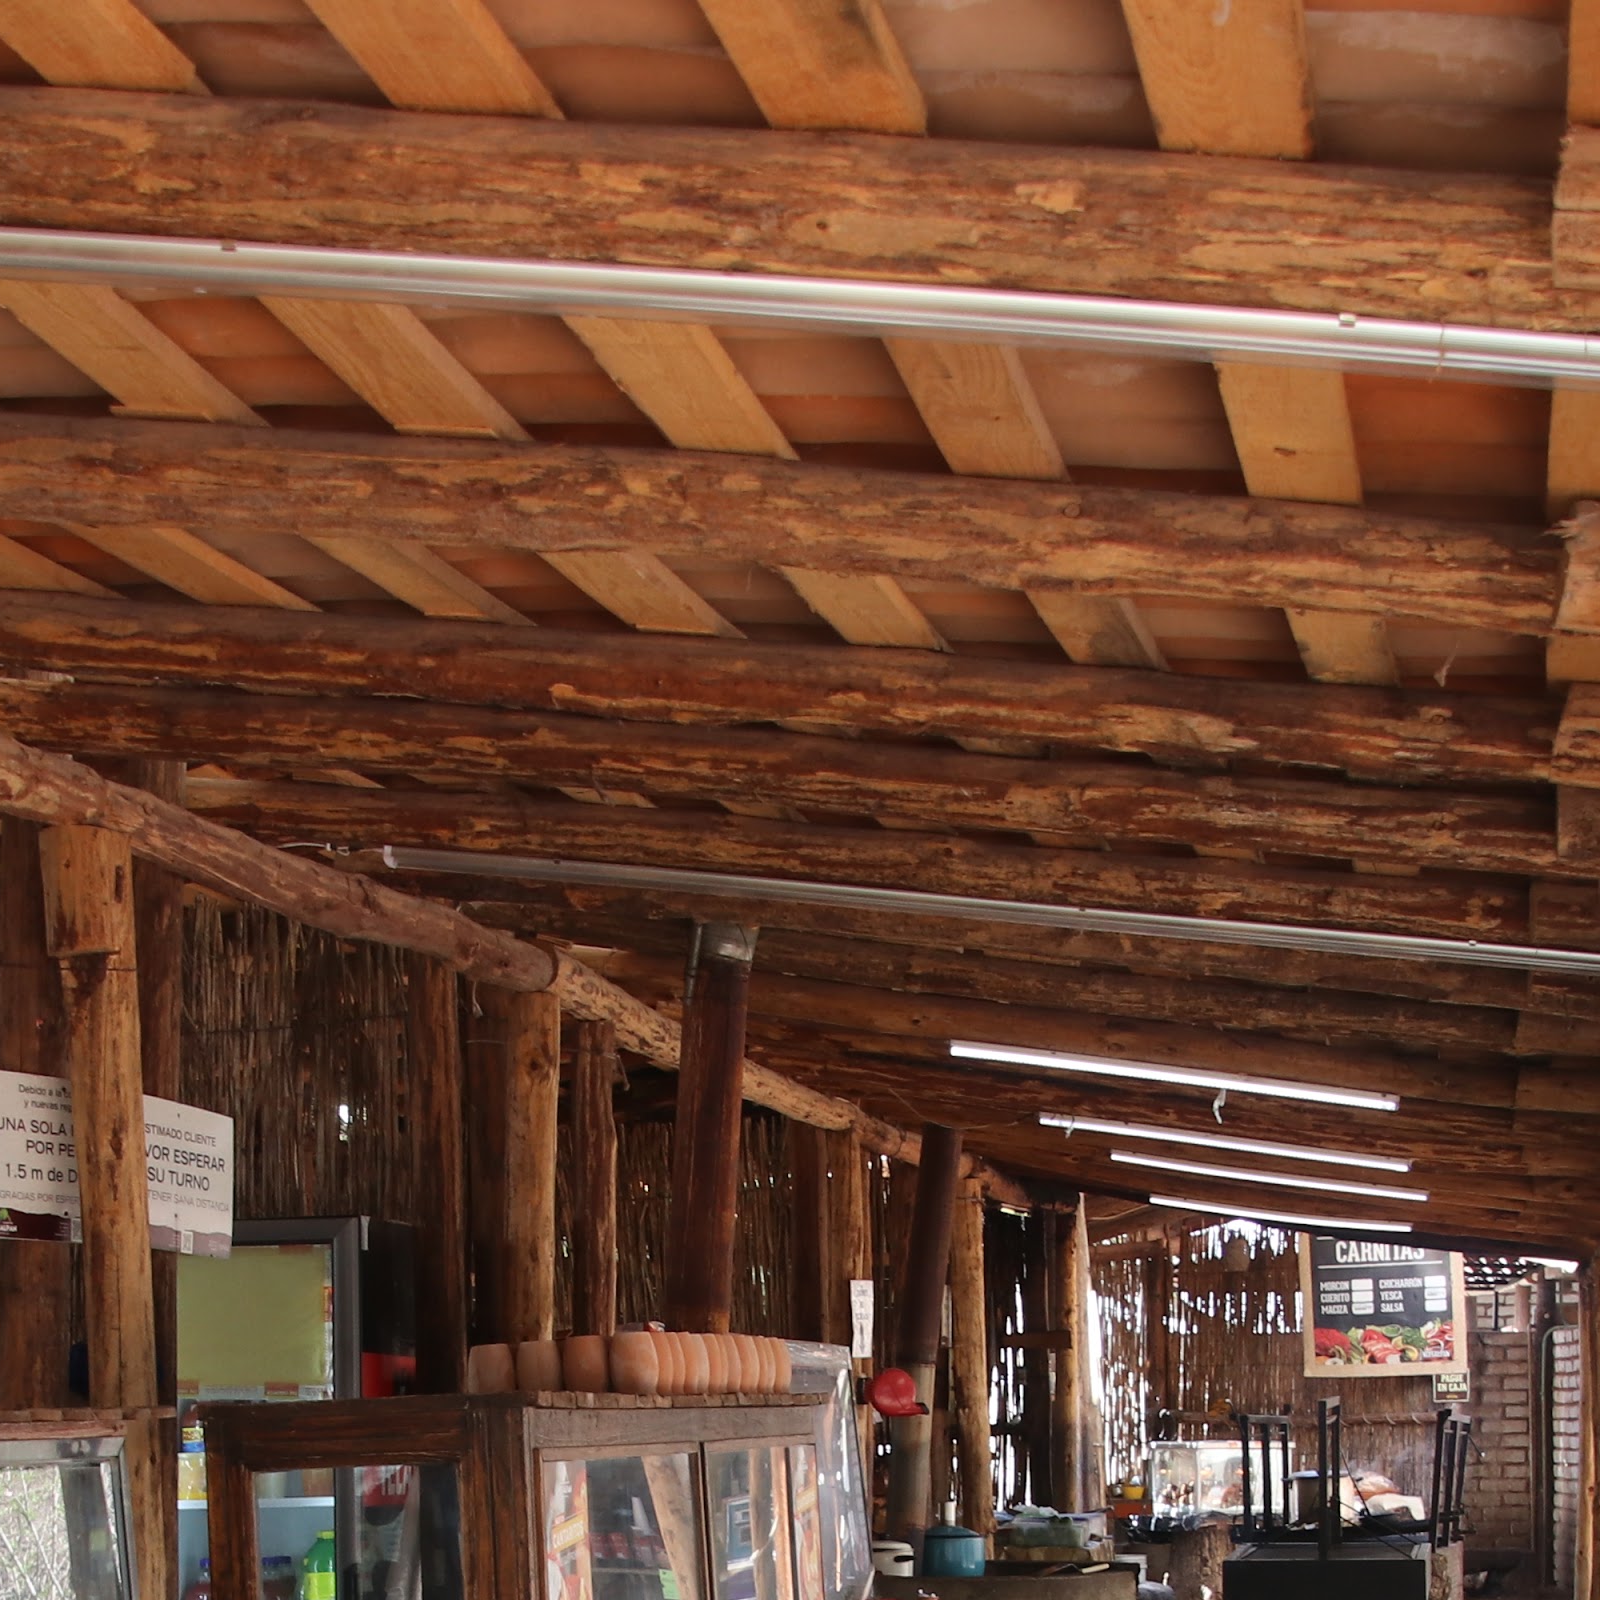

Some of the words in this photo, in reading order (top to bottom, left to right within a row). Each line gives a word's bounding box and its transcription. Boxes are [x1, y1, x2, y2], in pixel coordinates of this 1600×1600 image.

[18, 1084, 47, 1097] Debido
[30, 1100, 59, 1110] nuevas
[30, 1119, 67, 1137] SOLA
[144, 1123, 182, 1140] STIMADO
[184, 1131, 216, 1147] CLIENTE
[26, 1139, 55, 1156] POR
[145, 1144, 170, 1162] VOR
[173, 1148, 225, 1173] ESPERAR
[5, 1163, 27, 1179] 1.5
[31, 1168, 43, 1180] m
[47, 1167, 63, 1182] de
[147, 1166, 165, 1183] SU
[168, 1170, 210, 1191] TURNO
[0, 1190, 36, 1201] GRACIAS
[37, 1193, 54, 1202] POR
[174, 1193, 195, 1206] SANA
[196, 1199, 230, 1212] DISTANCIA
[1335, 1241, 1425, 1263] CARNITAS
[1320, 1292, 1350, 1303] CUERITO
[1320, 1304, 1349, 1315] MACIZA
[1380, 1302, 1405, 1313] SALSA
[1440, 1374, 1464, 1383] PAGUE
[1437, 1383, 1448, 1392] EN
[1448, 1383, 1468, 1392] CAJA
